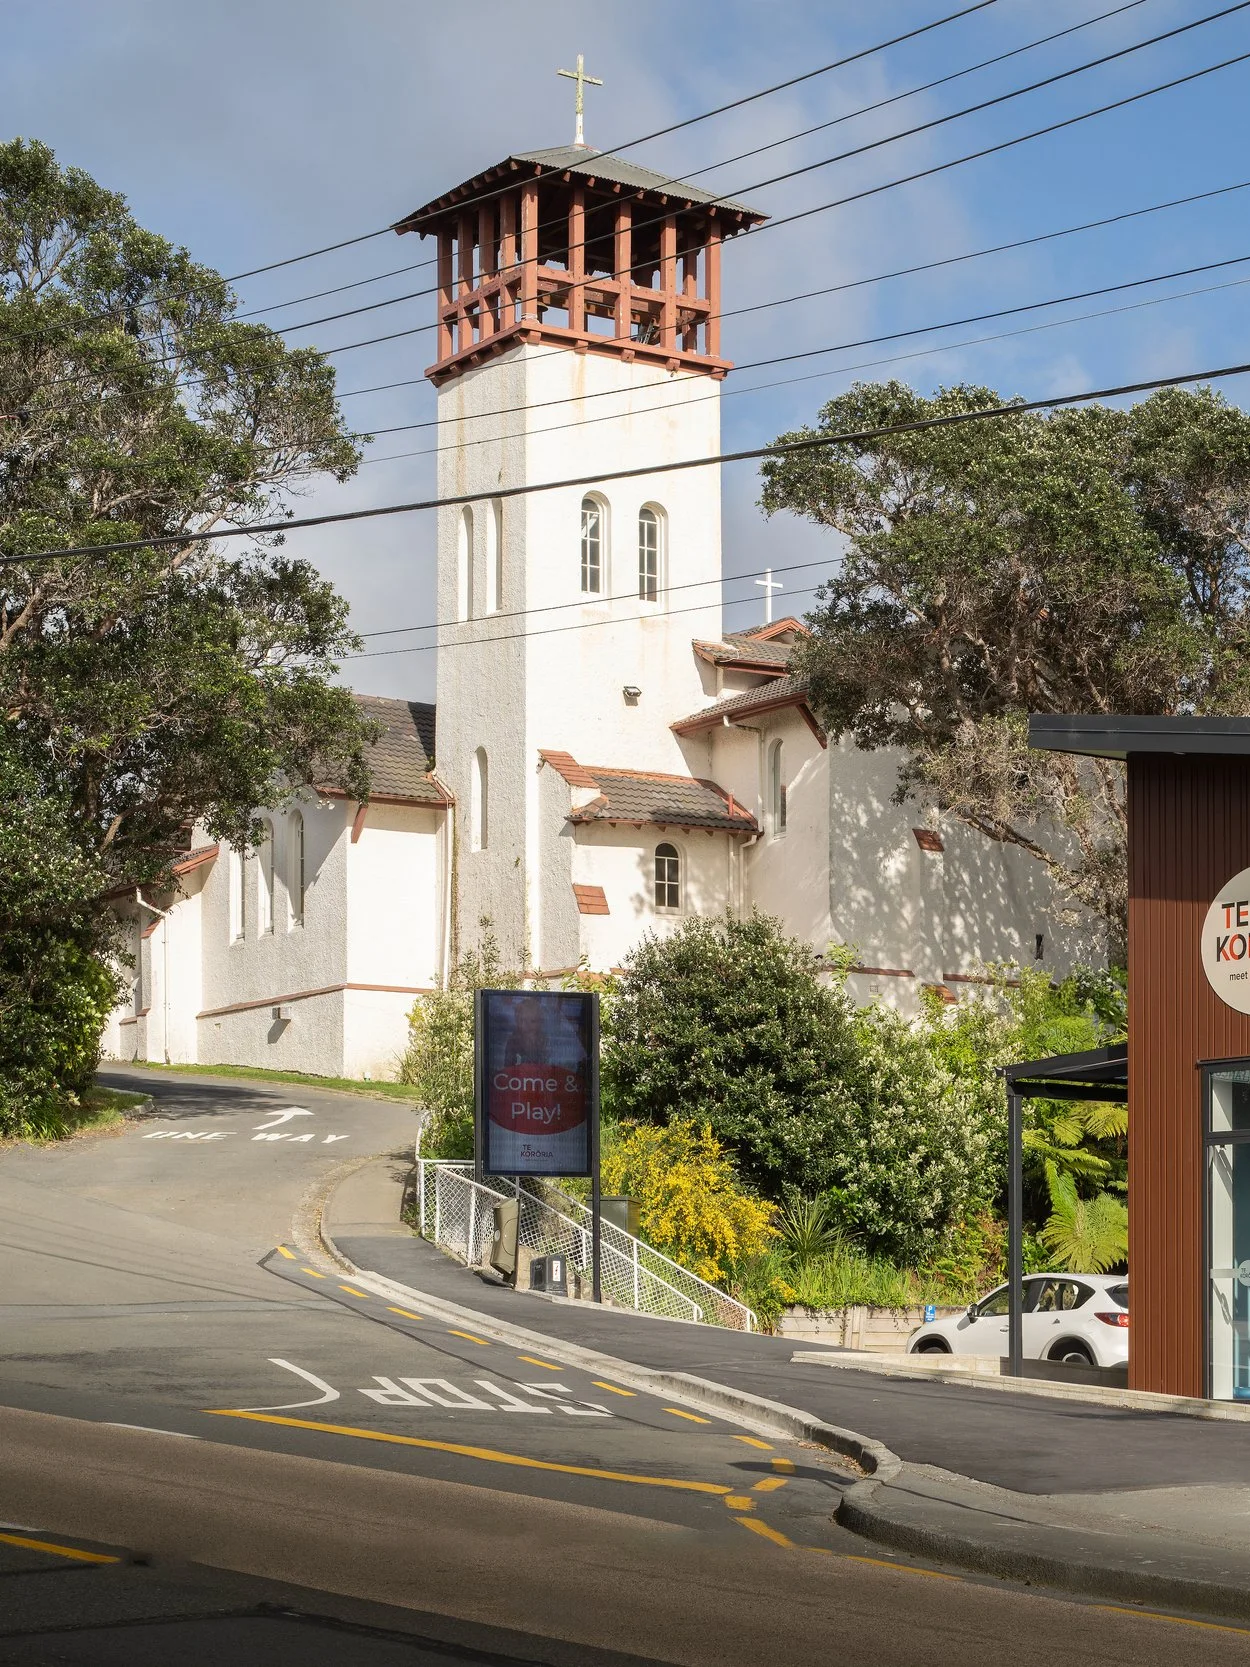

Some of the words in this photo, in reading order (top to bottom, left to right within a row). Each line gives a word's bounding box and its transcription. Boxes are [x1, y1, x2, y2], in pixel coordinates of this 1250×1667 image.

[1222, 900, 1248, 928] TE
[1230, 971, 1248, 981] meet
[493, 1073, 558, 1092] Come
[564, 1075, 579, 1092] &
[511, 1102, 561, 1124] Play!
[142, 1131, 238, 1140] ONE
[250, 1132, 350, 1144] WAY
[356, 1376, 616, 1418] STOP
